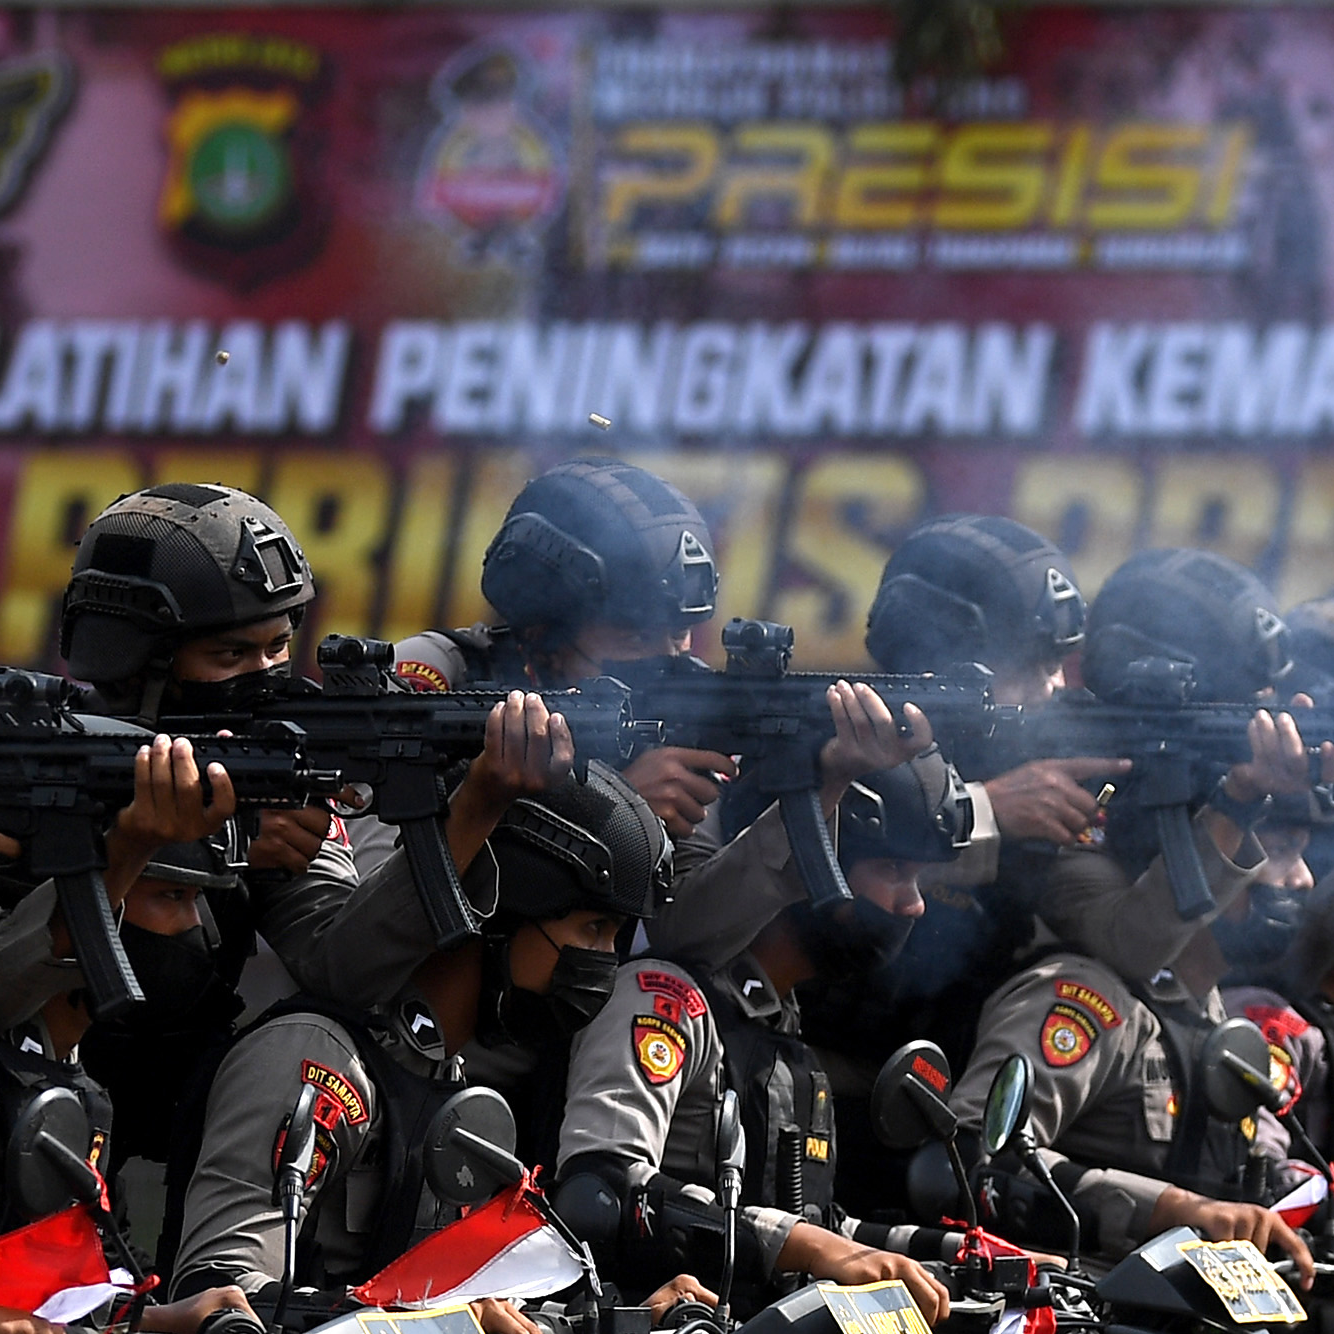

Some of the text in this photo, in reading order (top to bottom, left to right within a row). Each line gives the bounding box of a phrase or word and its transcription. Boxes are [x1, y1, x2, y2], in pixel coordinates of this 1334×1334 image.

[603, 120, 1253, 231] PRESISI
[370, 319, 1056, 434] PENINGKATAN
[307, 1066, 362, 1120] DIT SAMAPTA
